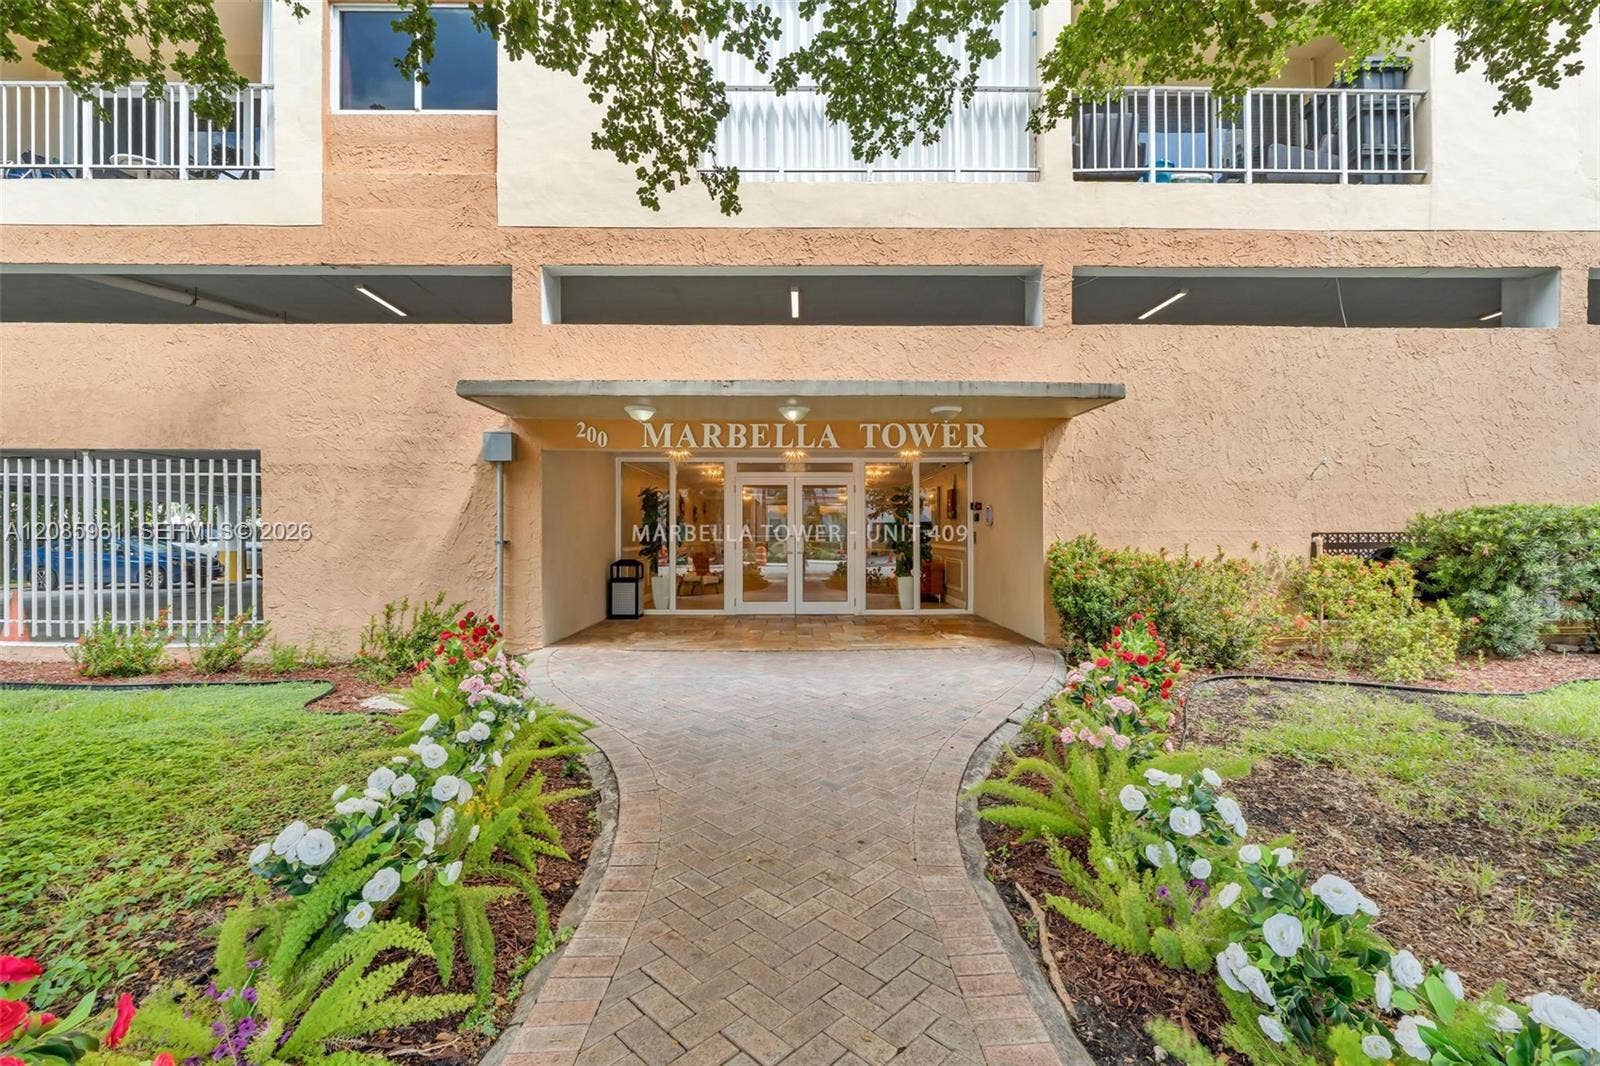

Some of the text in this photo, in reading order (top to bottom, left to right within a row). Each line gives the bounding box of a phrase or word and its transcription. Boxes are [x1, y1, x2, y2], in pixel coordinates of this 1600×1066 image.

[576, 422, 608, 448] 200
[641, 422, 988, 449] MARBELLA TOWER
